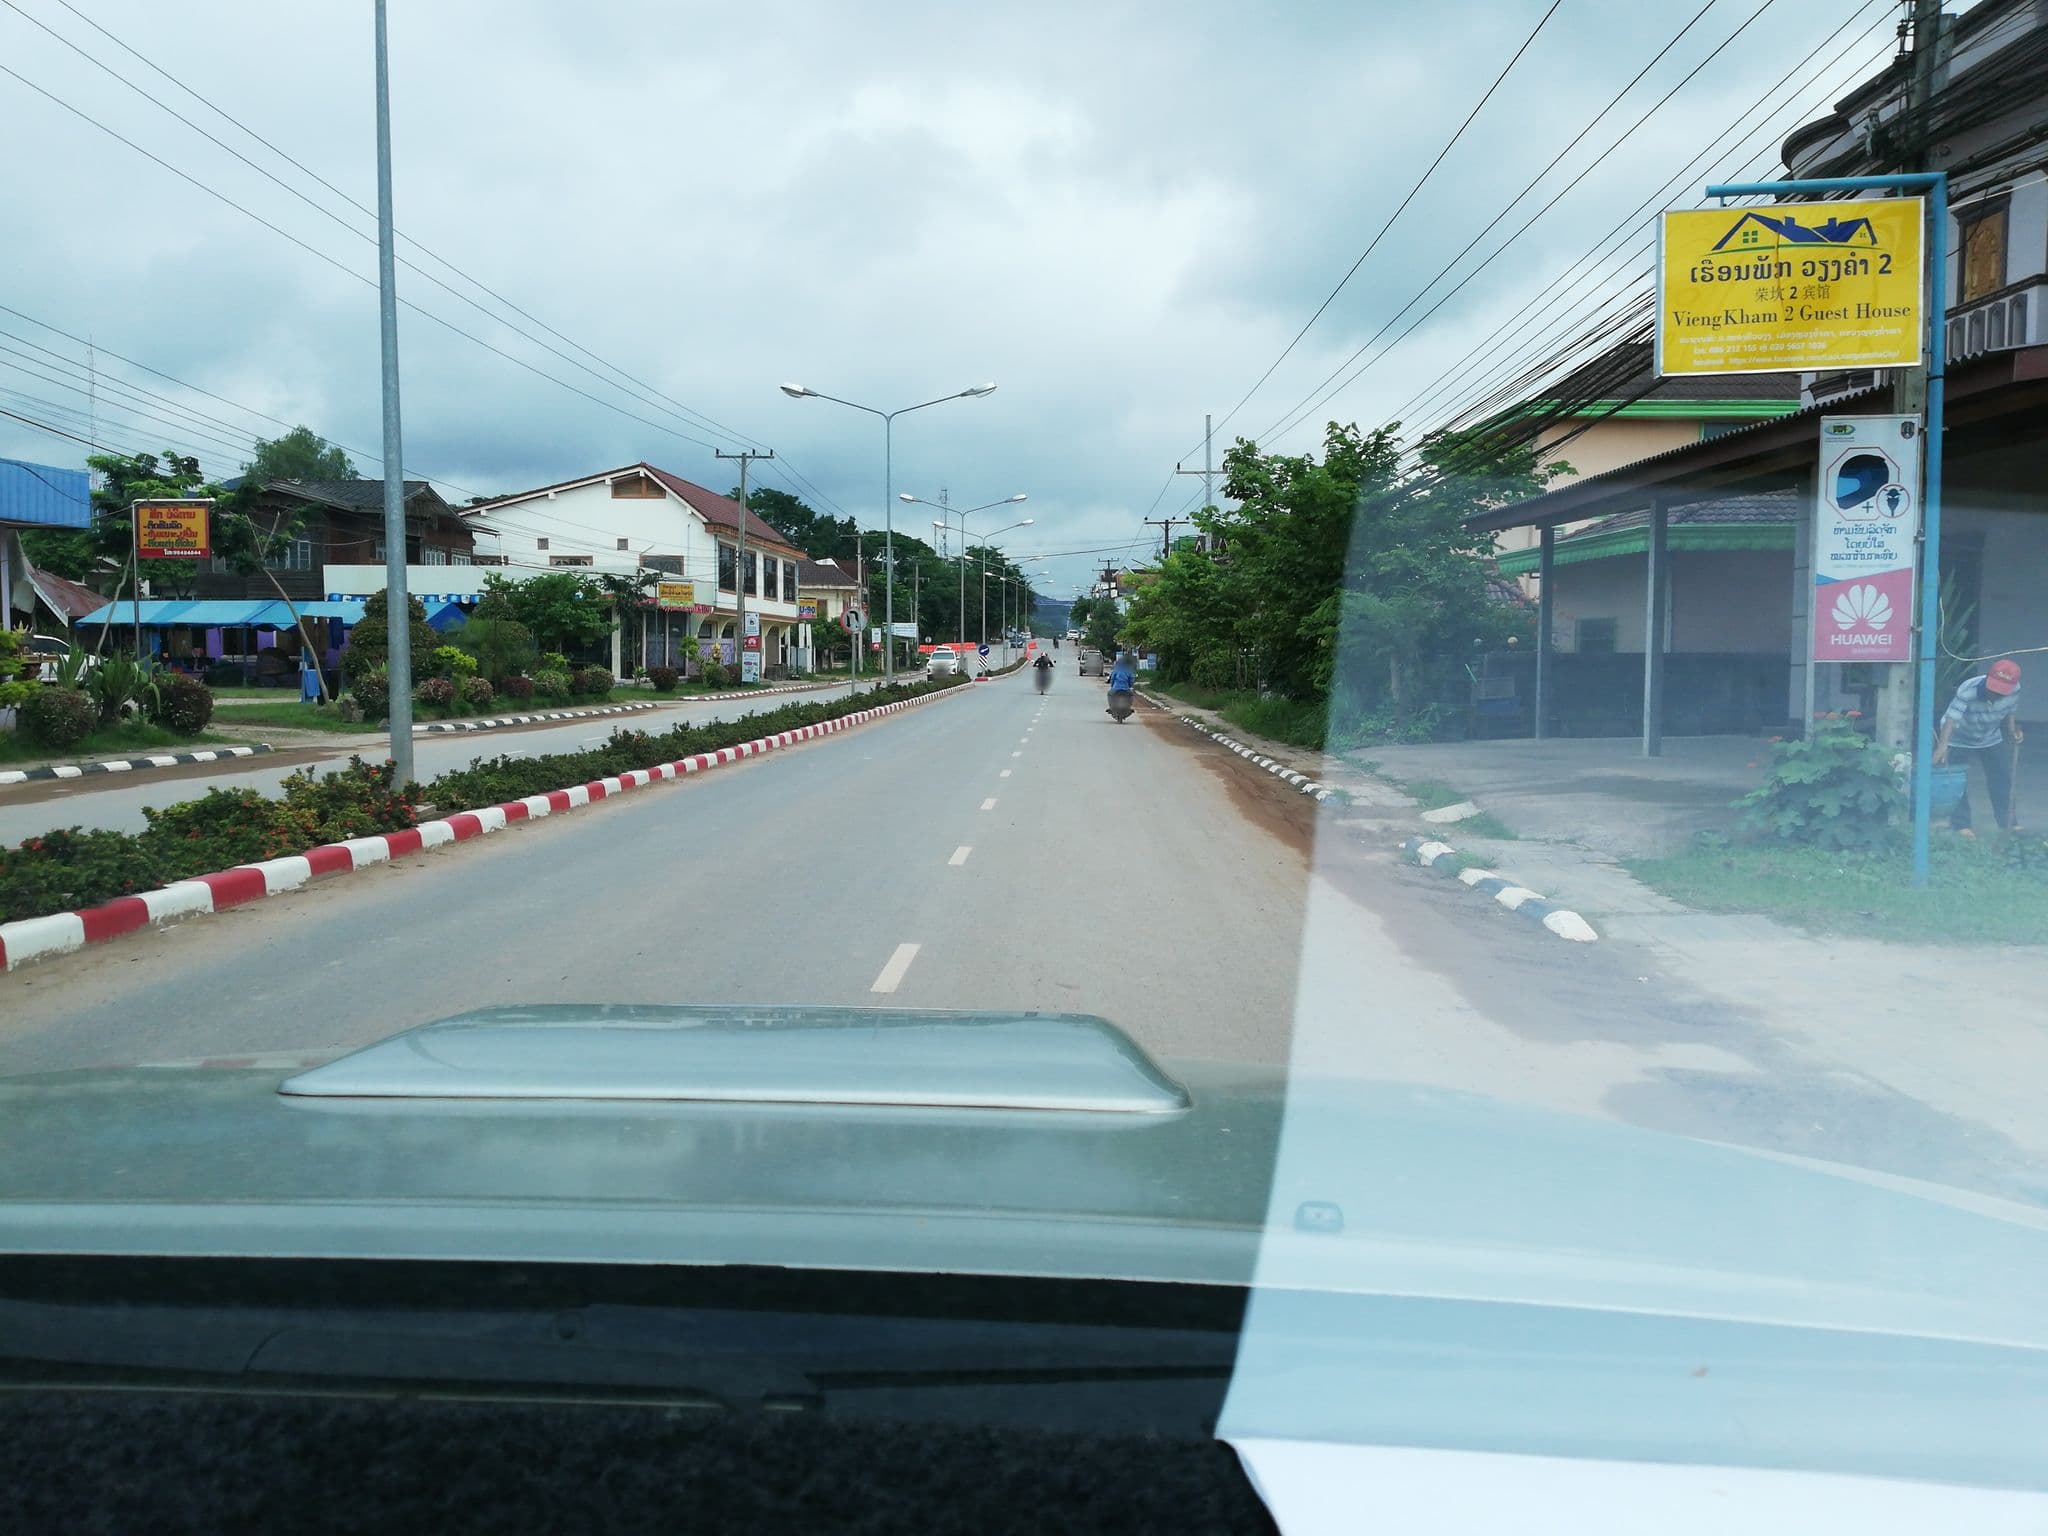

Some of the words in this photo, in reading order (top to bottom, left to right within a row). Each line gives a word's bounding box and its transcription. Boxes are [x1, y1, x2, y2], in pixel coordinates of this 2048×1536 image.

[1878, 254, 1892, 275] 2
[1790, 286, 1798, 300] 2
[1803, 284, 1830, 301] 宾馆
[1784, 306, 1794, 322] 2
[1800, 304, 1849, 321] Guest
[1856, 302, 1911, 320] House
[1831, 634, 1892, 645] HUAWEI
